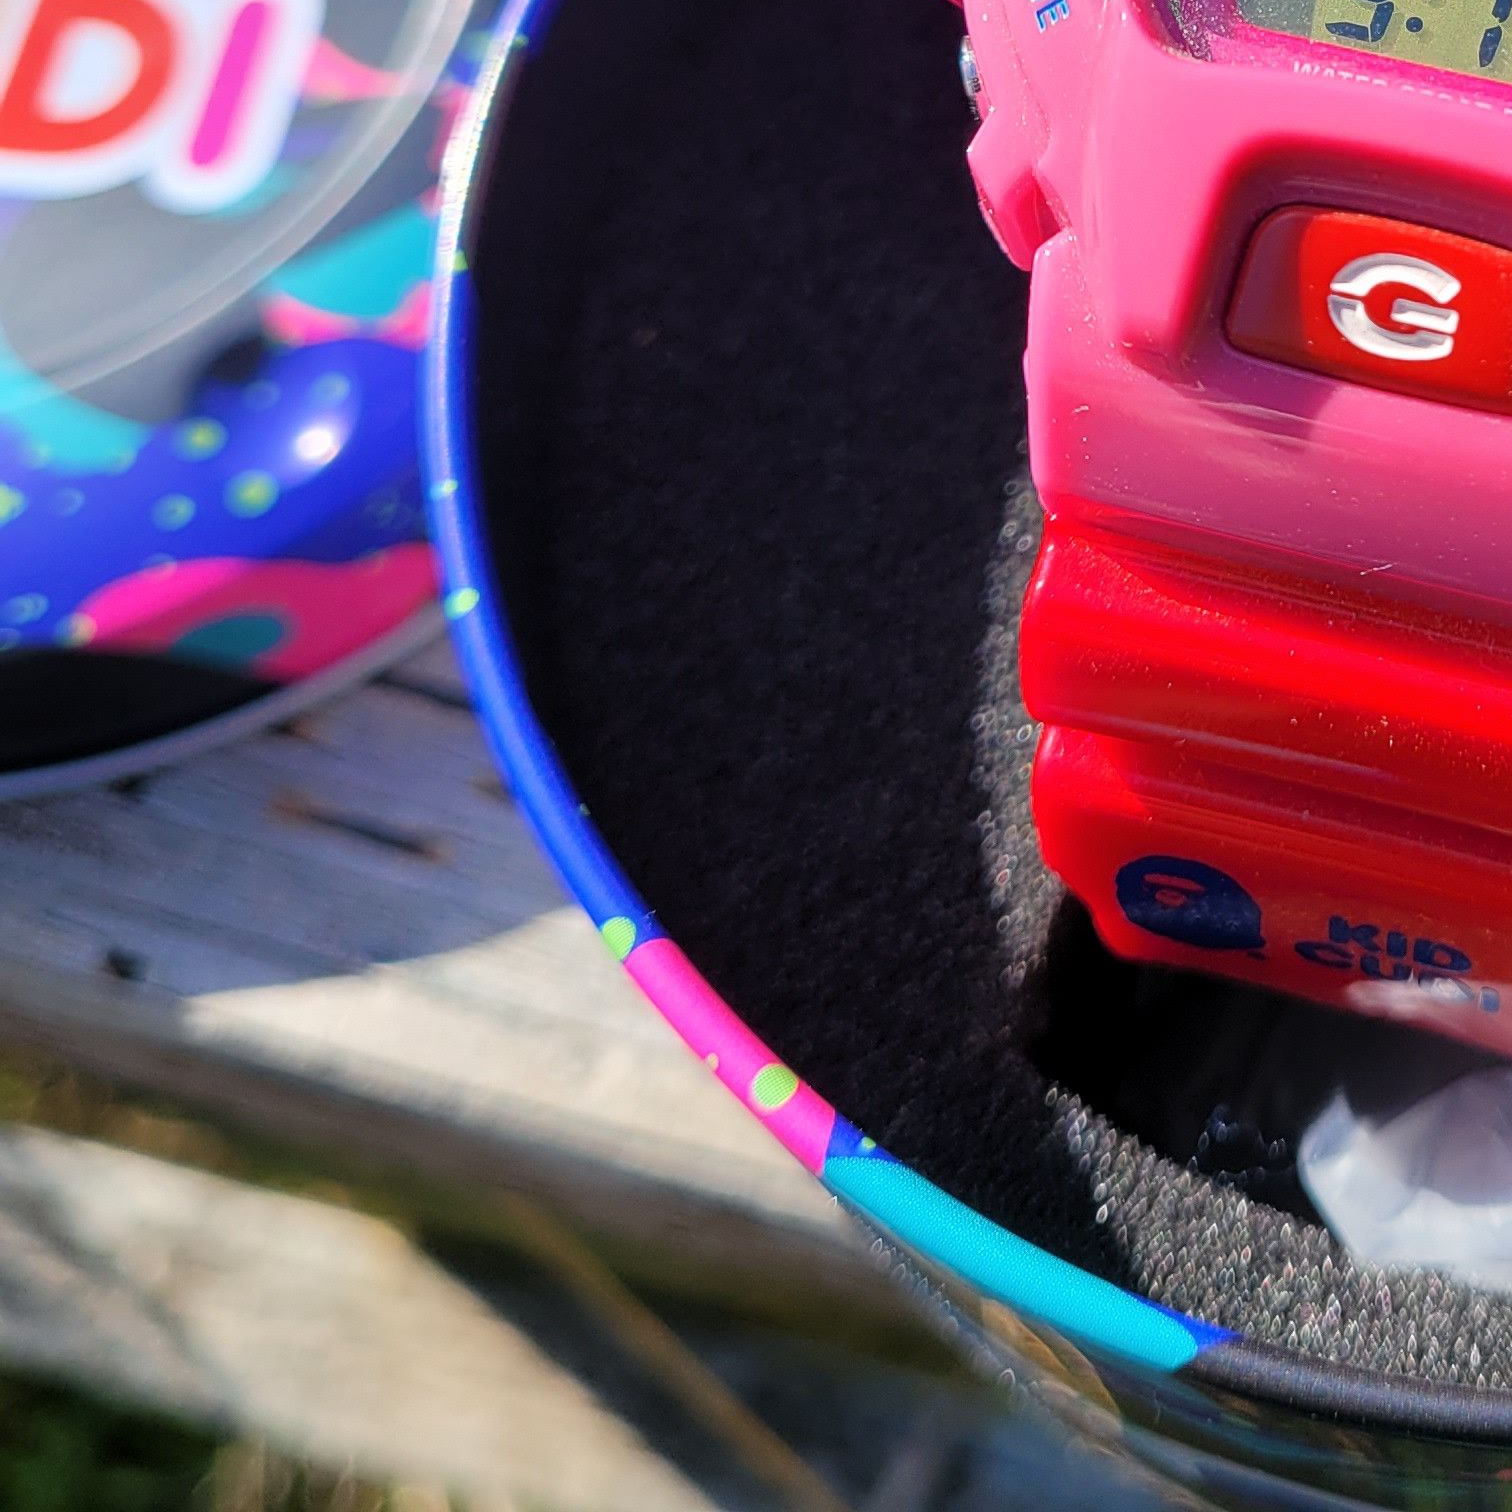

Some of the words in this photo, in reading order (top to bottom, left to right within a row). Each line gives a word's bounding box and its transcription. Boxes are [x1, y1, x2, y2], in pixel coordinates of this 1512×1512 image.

[1326, 251, 1462, 361] G
[1294, 940, 1502, 1014] CUDI
[1327, 914, 1472, 972] KID
